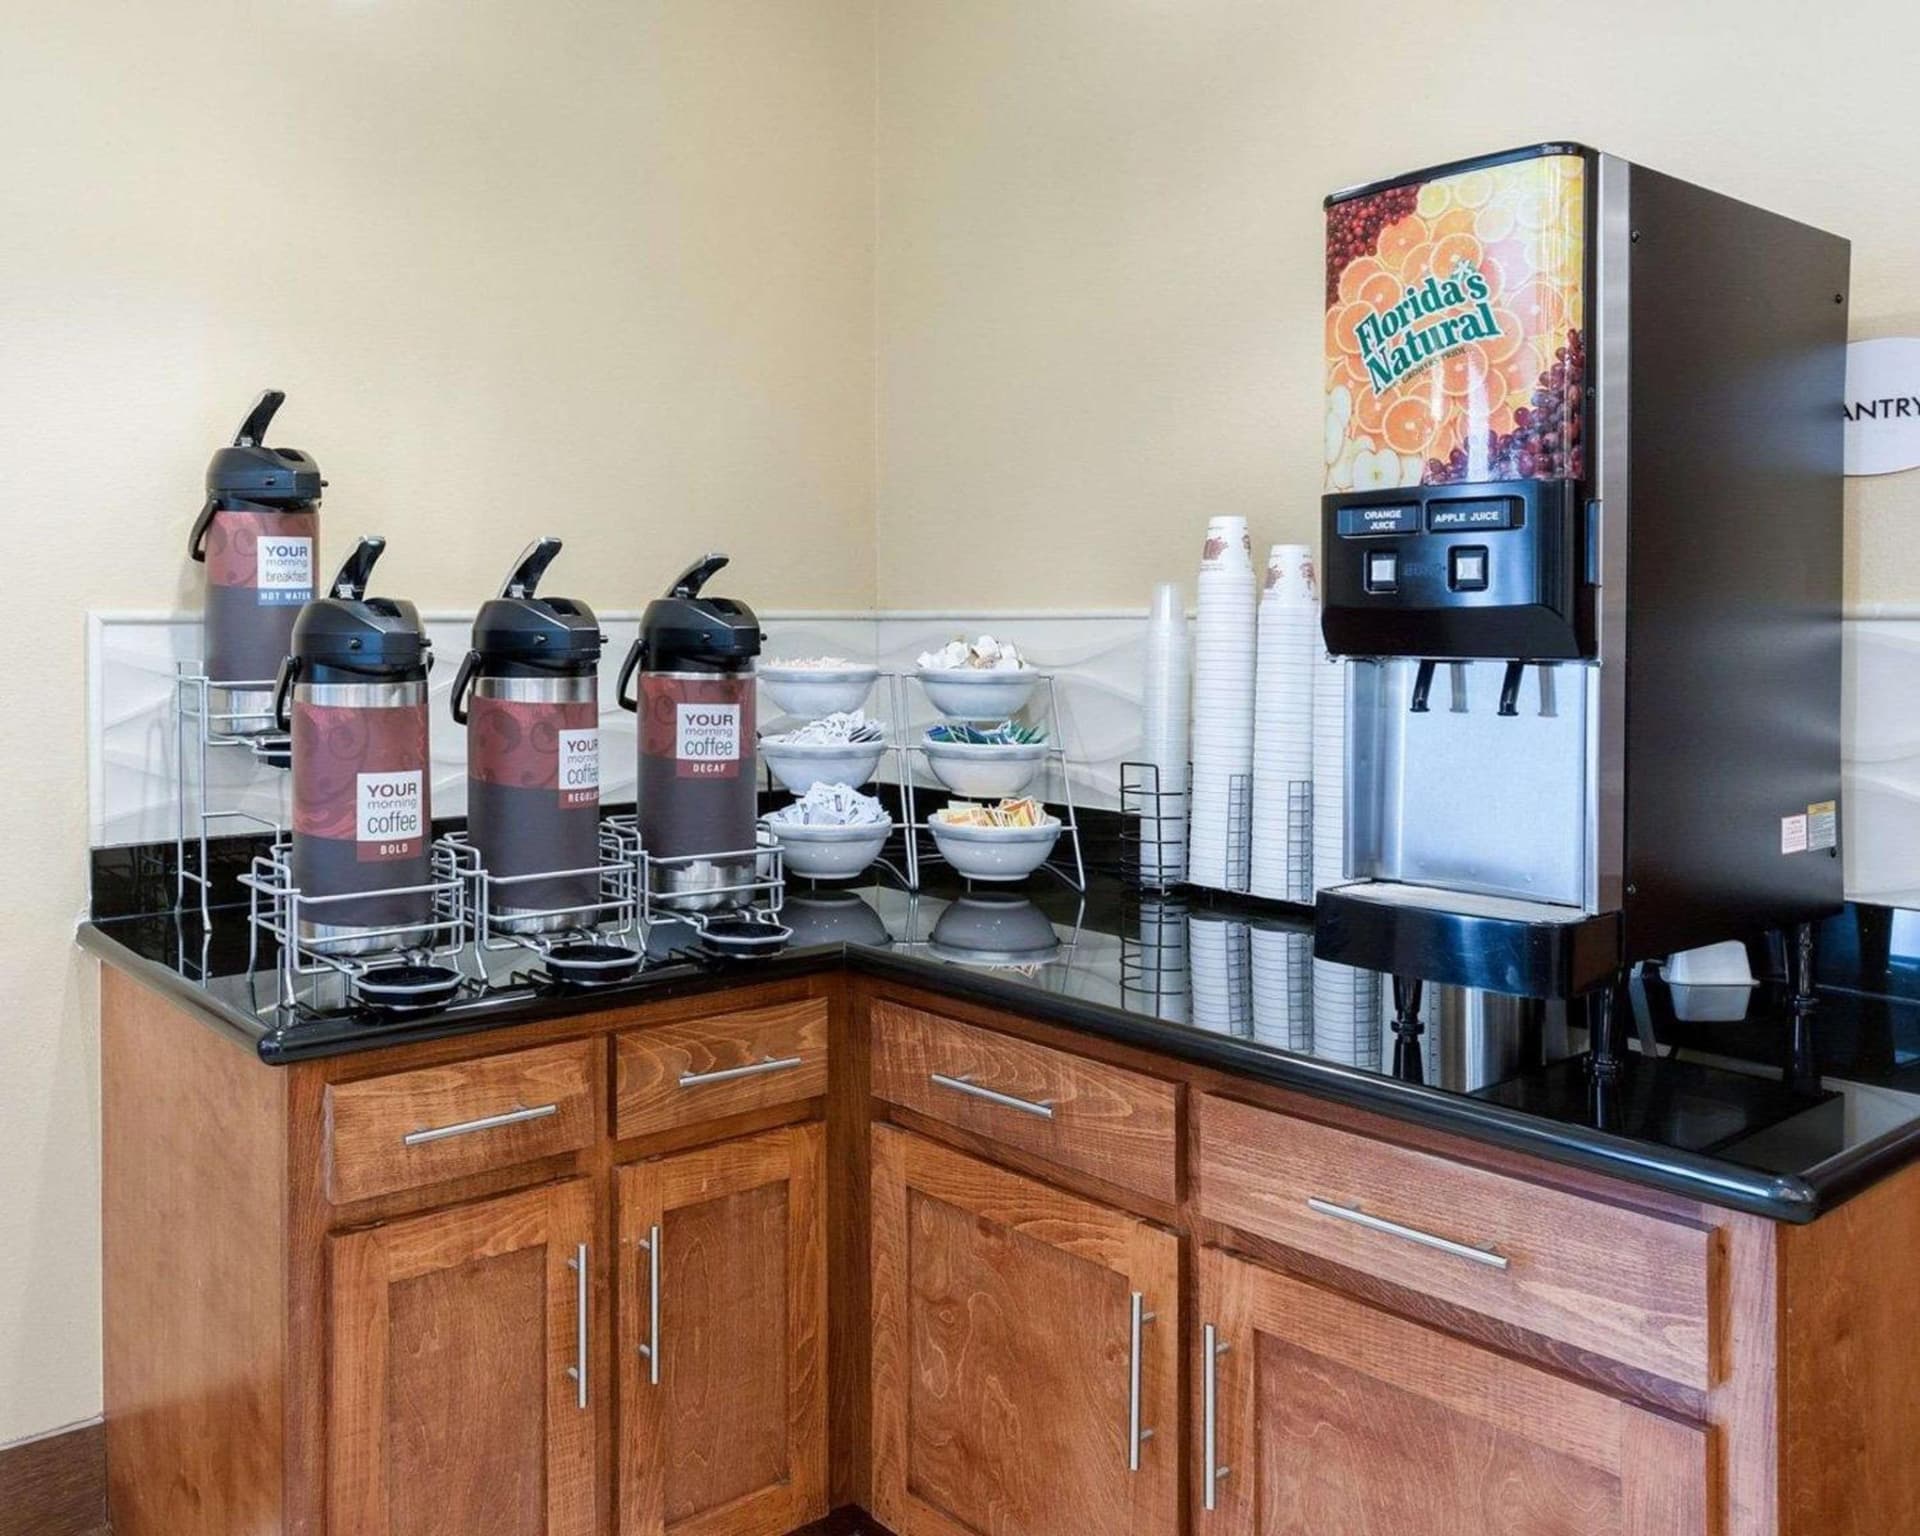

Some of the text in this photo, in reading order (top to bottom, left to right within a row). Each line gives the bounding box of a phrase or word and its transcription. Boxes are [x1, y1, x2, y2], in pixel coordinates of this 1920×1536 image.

[1355, 270, 1488, 358] Florida's
[1366, 302, 1501, 394] Natural
[1364, 510, 1402, 520] ORANGE
[1435, 511, 1499, 523] APPLE JUICE
[1370, 521, 1396, 530] JUICE
[266, 545, 308, 557] YOUR
[685, 714, 733, 726] YOUR
[685, 728, 733, 738] morning
[684, 737, 733, 756] coffee
[692, 763, 726, 774] DECAF
[367, 782, 417, 798] YOUR
[367, 798, 417, 810] morning
[367, 811, 417, 834] coffee
[380, 843, 408, 855] BOLD
